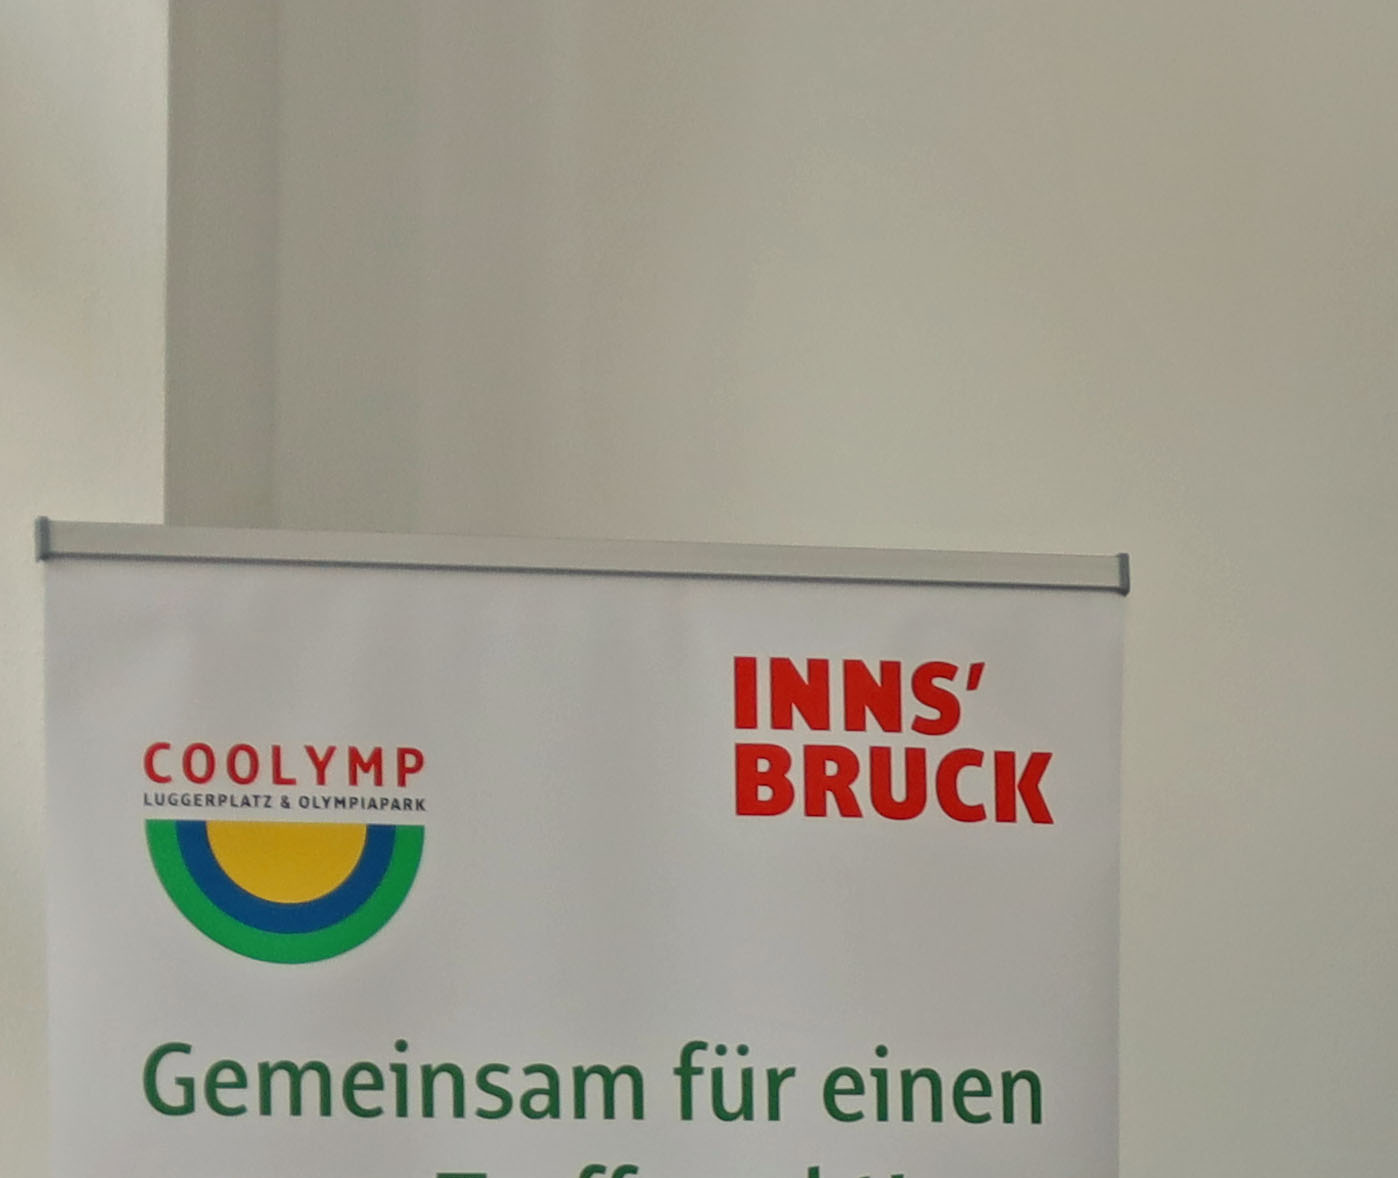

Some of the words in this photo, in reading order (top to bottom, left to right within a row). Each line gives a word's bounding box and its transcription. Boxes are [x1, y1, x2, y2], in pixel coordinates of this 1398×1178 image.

[733, 656, 986, 734] INNS'
[143, 742, 425, 787] COOLYMP
[143, 793, 272, 808] LUGGERPLATZ
[280, 795, 291, 809] &
[298, 795, 426, 811] OLYMPIAPARK
[733, 742, 1054, 825] BRUCK
[142, 1039, 646, 1122] Gemeinsam
[673, 1040, 797, 1123] für
[821, 1044, 1043, 1125] einen
